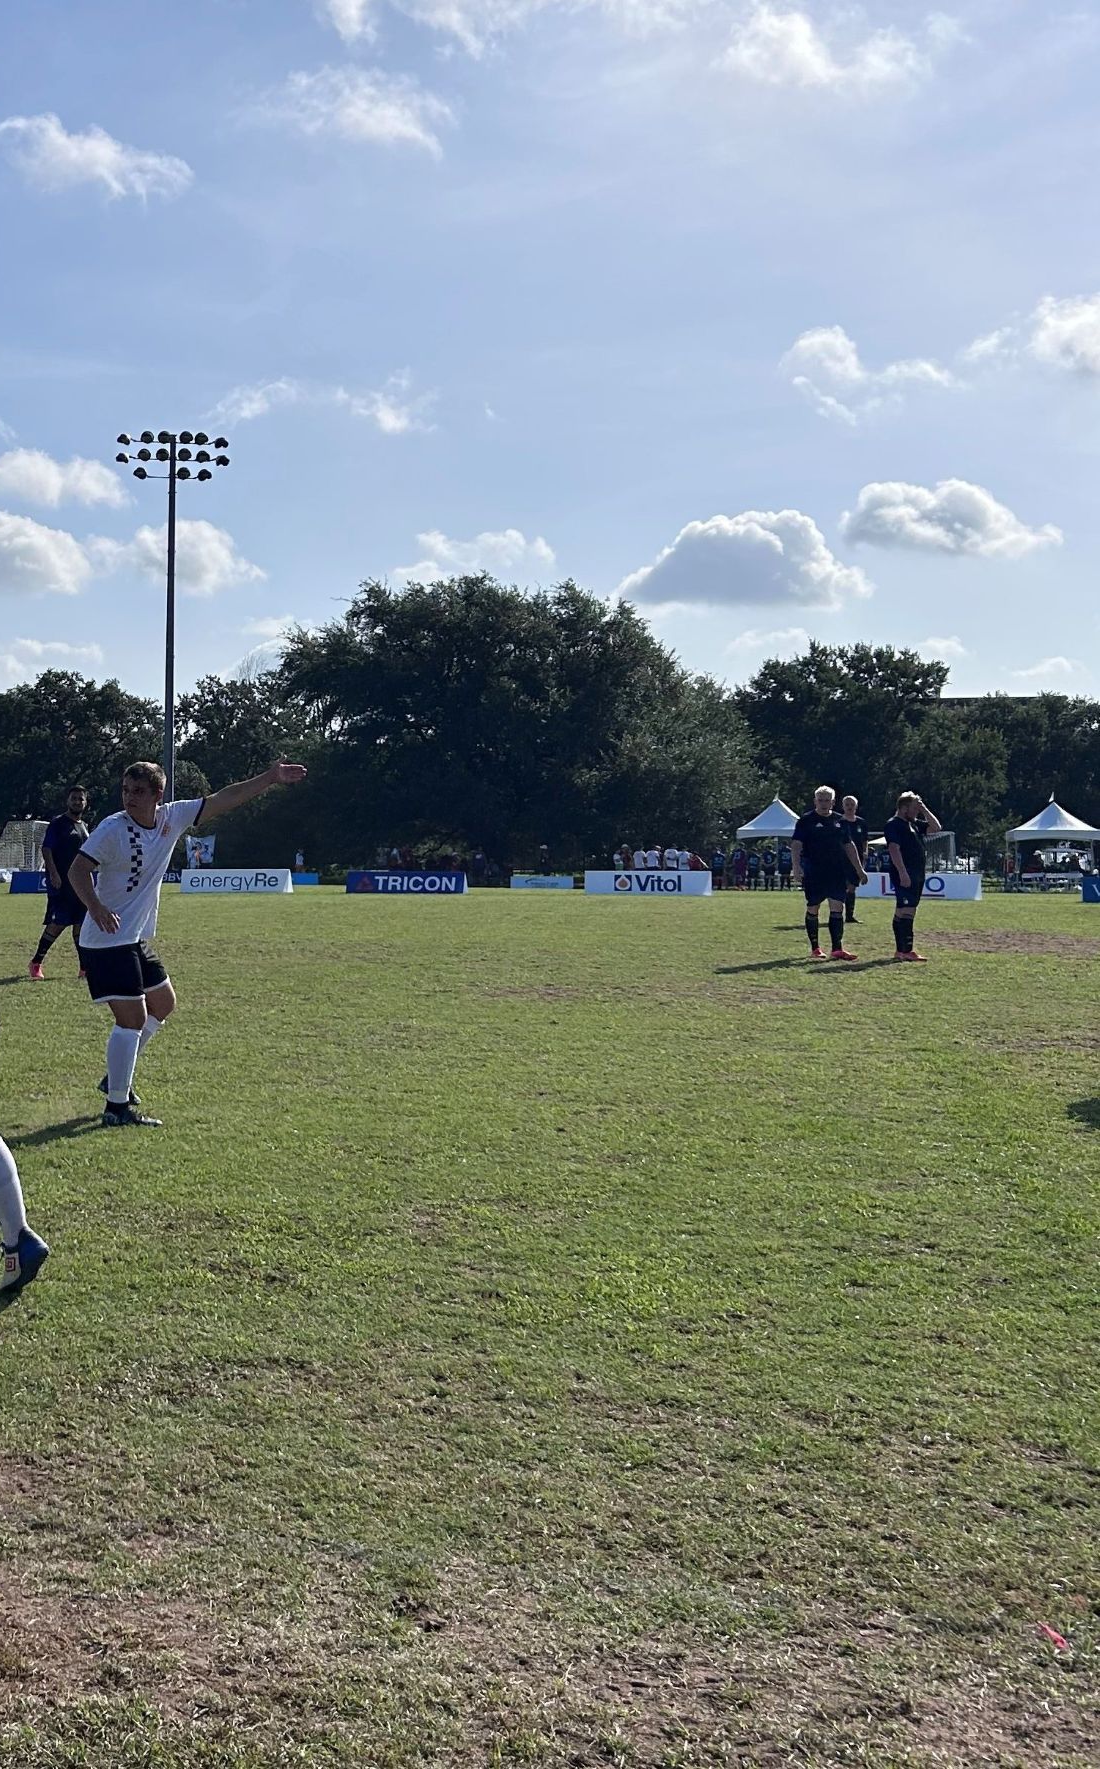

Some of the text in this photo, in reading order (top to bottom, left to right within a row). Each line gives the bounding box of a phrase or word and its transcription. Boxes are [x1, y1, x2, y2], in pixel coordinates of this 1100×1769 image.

[162, 872, 180, 882] BBV
[190, 872, 279, 891] energyRe
[374, 876, 456, 891] TRICON
[635, 874, 682, 892] Vitol
